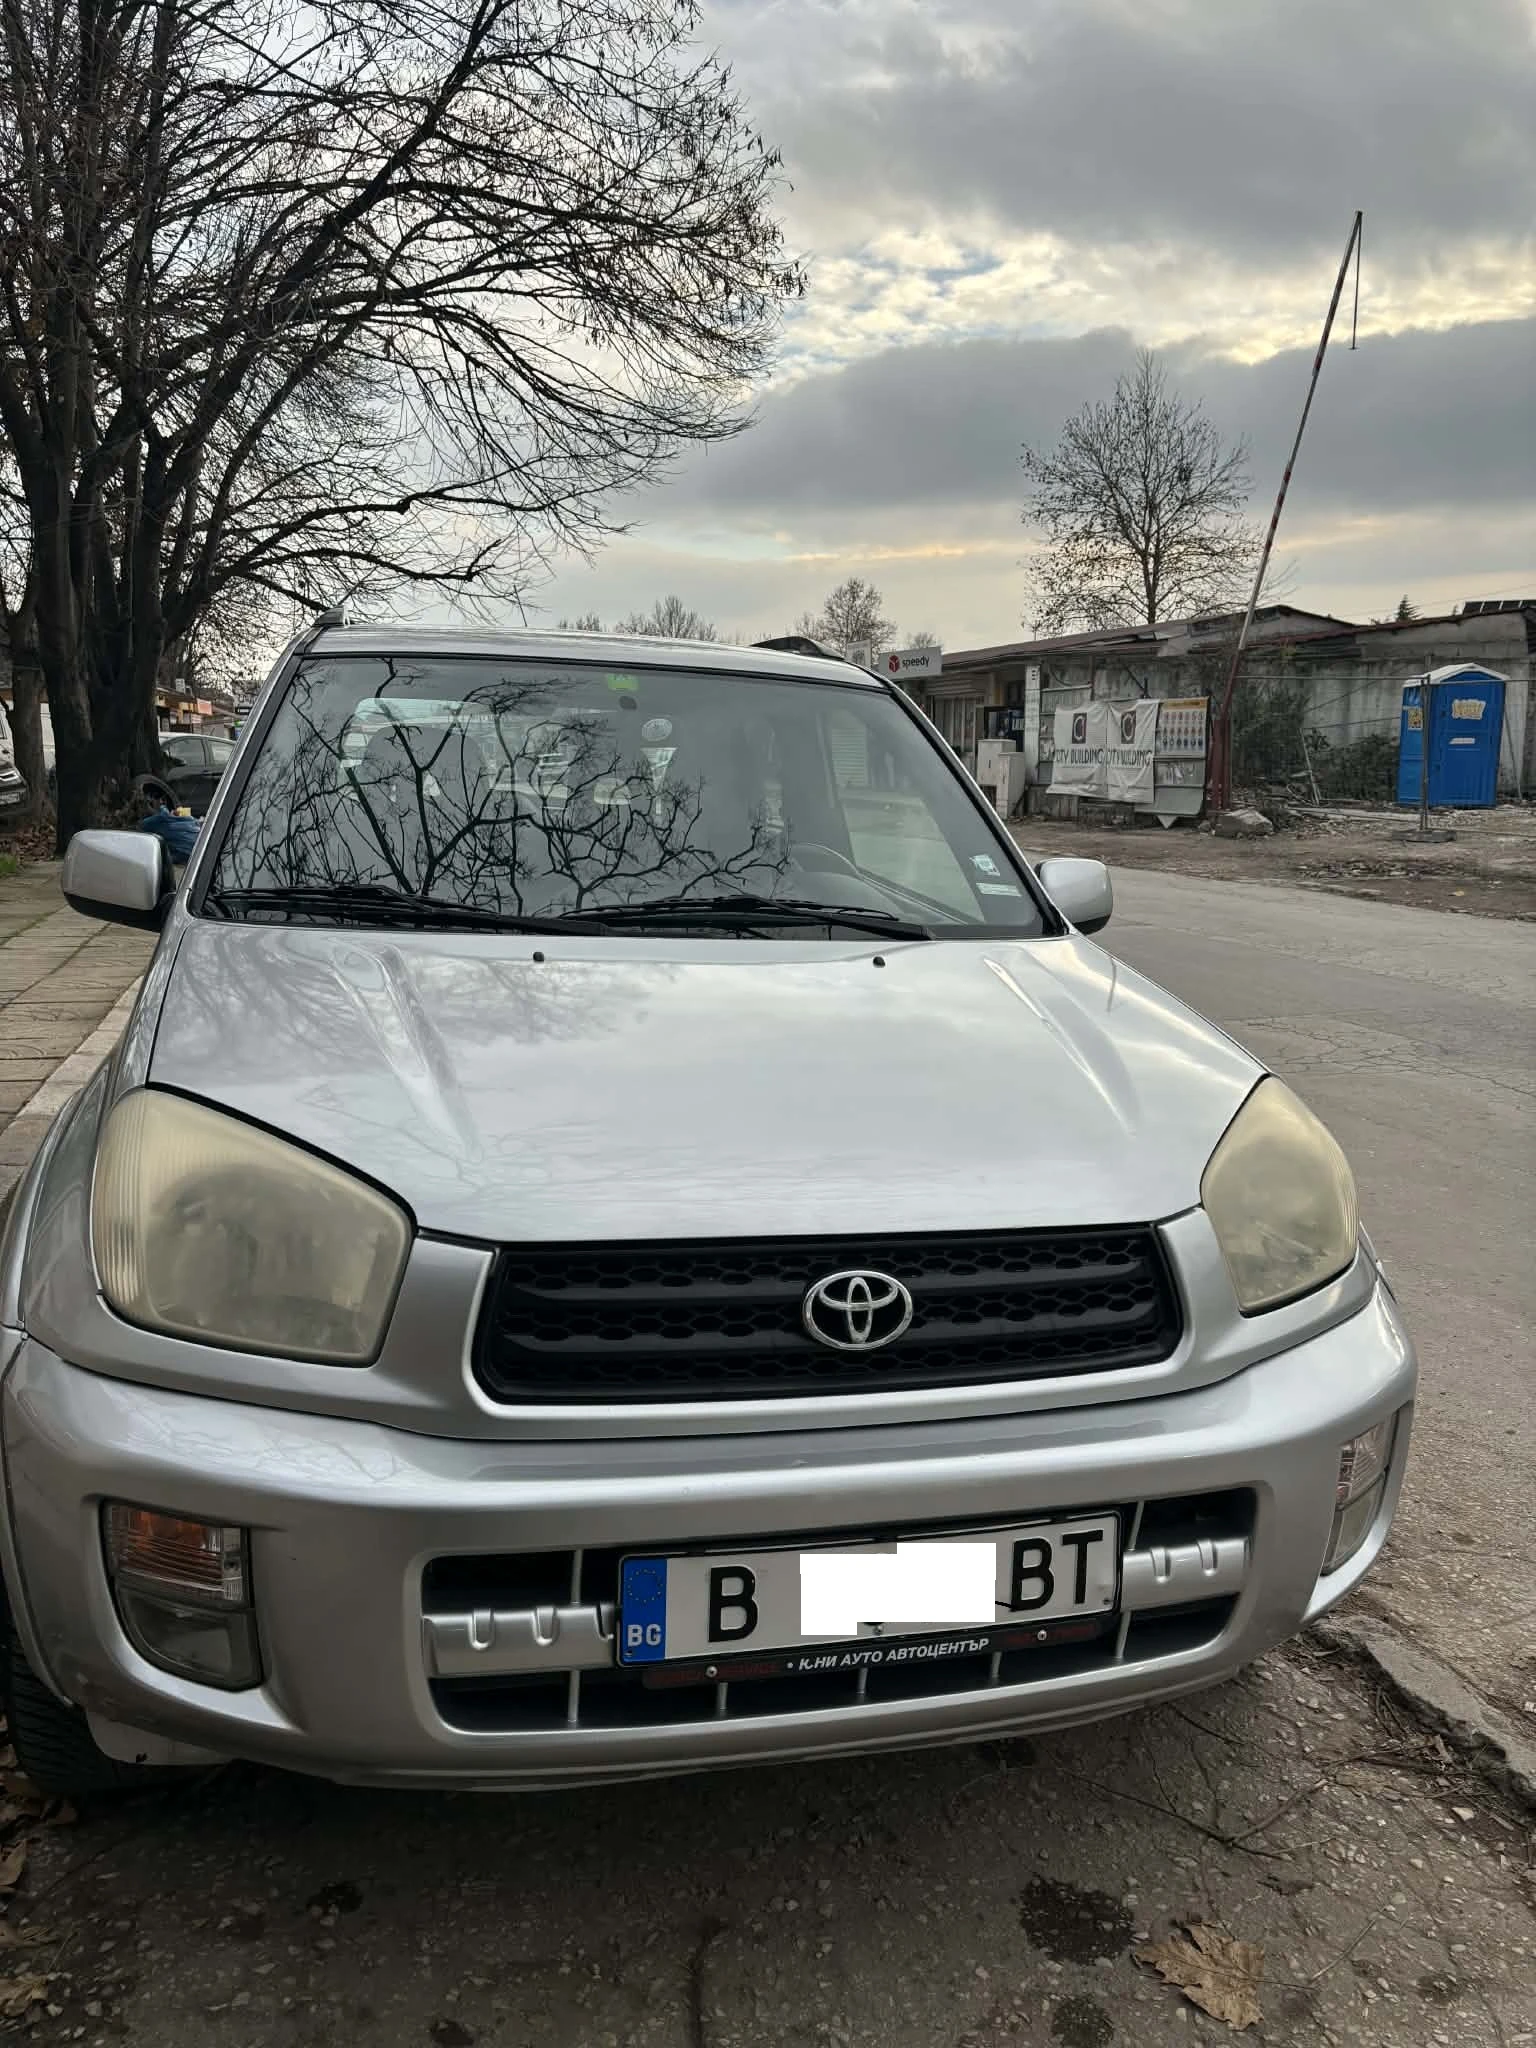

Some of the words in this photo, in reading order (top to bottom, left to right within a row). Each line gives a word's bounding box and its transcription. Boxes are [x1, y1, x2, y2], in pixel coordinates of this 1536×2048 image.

[902, 655, 929, 669] speedy
[1070, 748, 1105, 765] BUILDING
[1120, 749, 1153, 767] BUILDING
[627, 1623, 662, 1647] BG
[840, 1650, 883, 1667] АУТО
[886, 1638, 990, 1662] АВТОЦЕНТЪР
